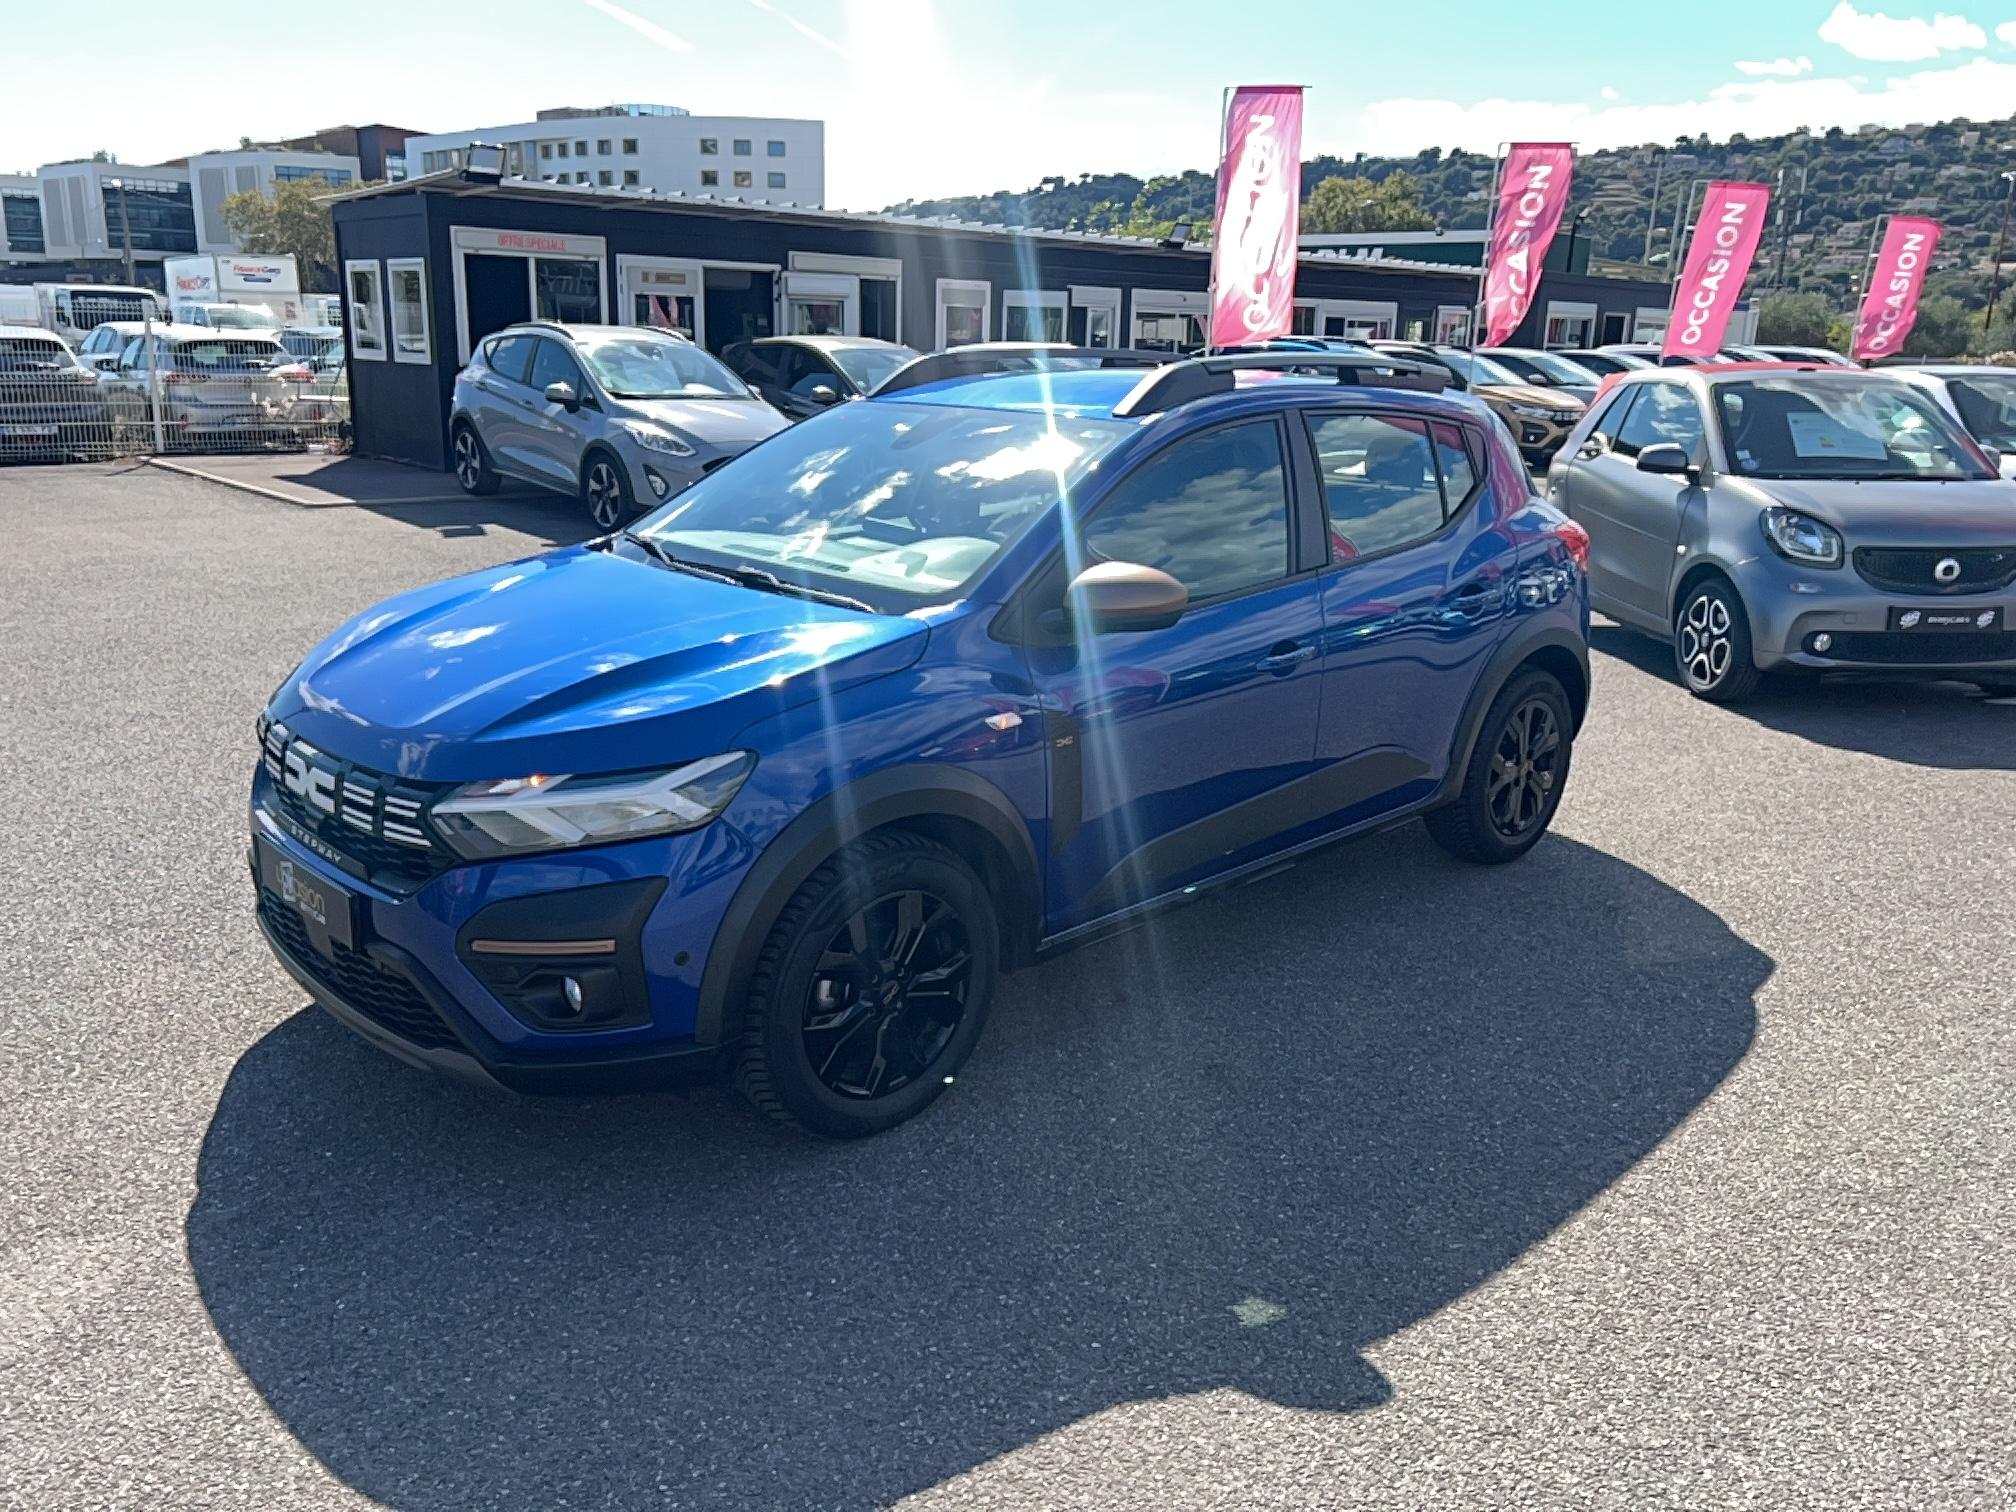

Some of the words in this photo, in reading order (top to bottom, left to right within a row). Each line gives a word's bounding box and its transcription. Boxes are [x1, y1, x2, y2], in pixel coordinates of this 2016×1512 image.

[1681, 202, 1747, 345] OCCASION
[1867, 233, 1925, 351] OCCASION
[290, 825, 342, 861] STEPWAY
